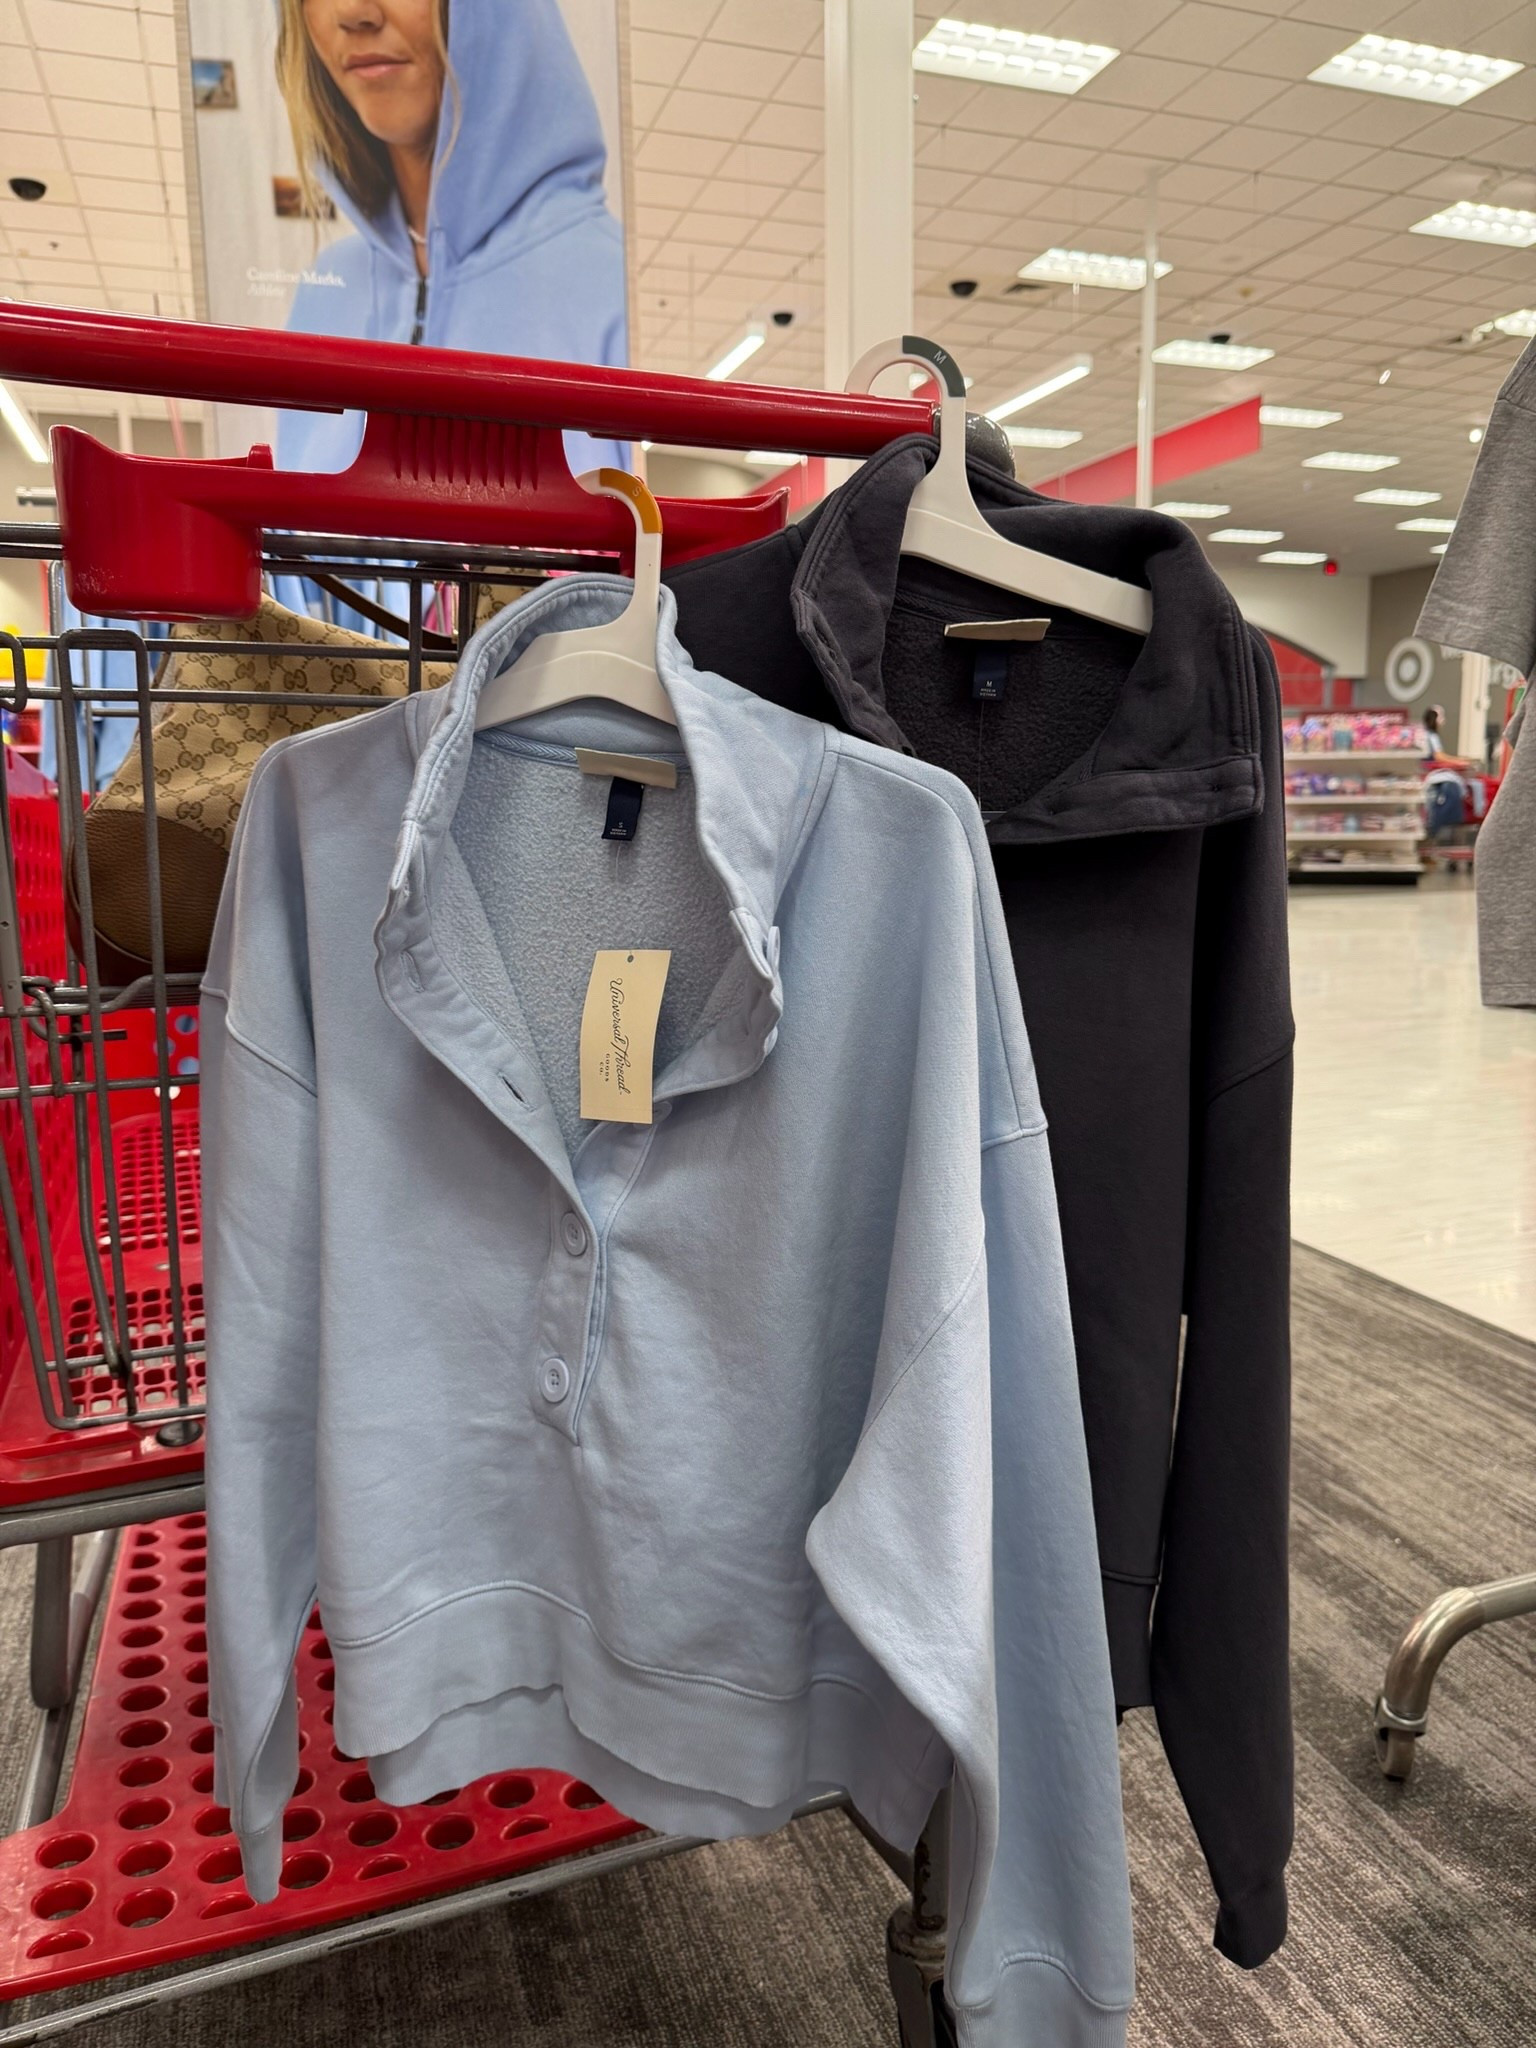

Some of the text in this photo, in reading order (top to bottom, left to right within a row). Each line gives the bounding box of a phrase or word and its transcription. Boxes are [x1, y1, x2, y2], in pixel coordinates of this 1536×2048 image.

[933, 350, 947, 365] M
[632, 486, 642, 497] S
[610, 977, 631, 1095] Universal Thread
